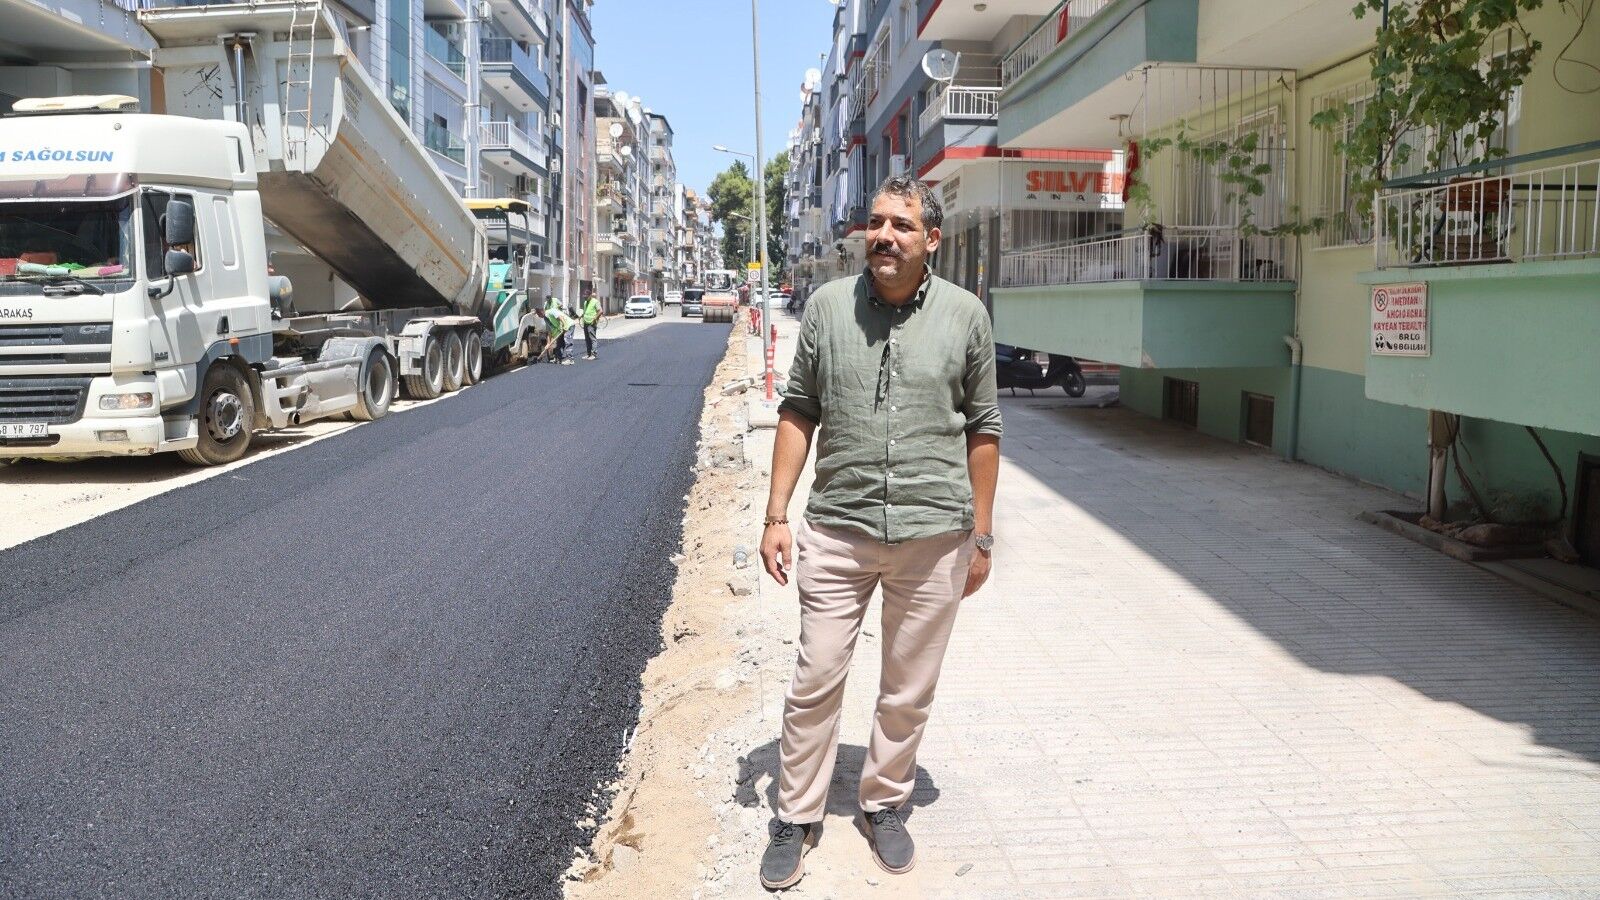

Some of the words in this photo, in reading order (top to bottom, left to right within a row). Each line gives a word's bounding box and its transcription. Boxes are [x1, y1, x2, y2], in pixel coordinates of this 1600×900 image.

[12, 147, 113, 161] SAĞOLSUN
[13, 424, 24, 434] YR
[30, 424, 45, 434] 797
